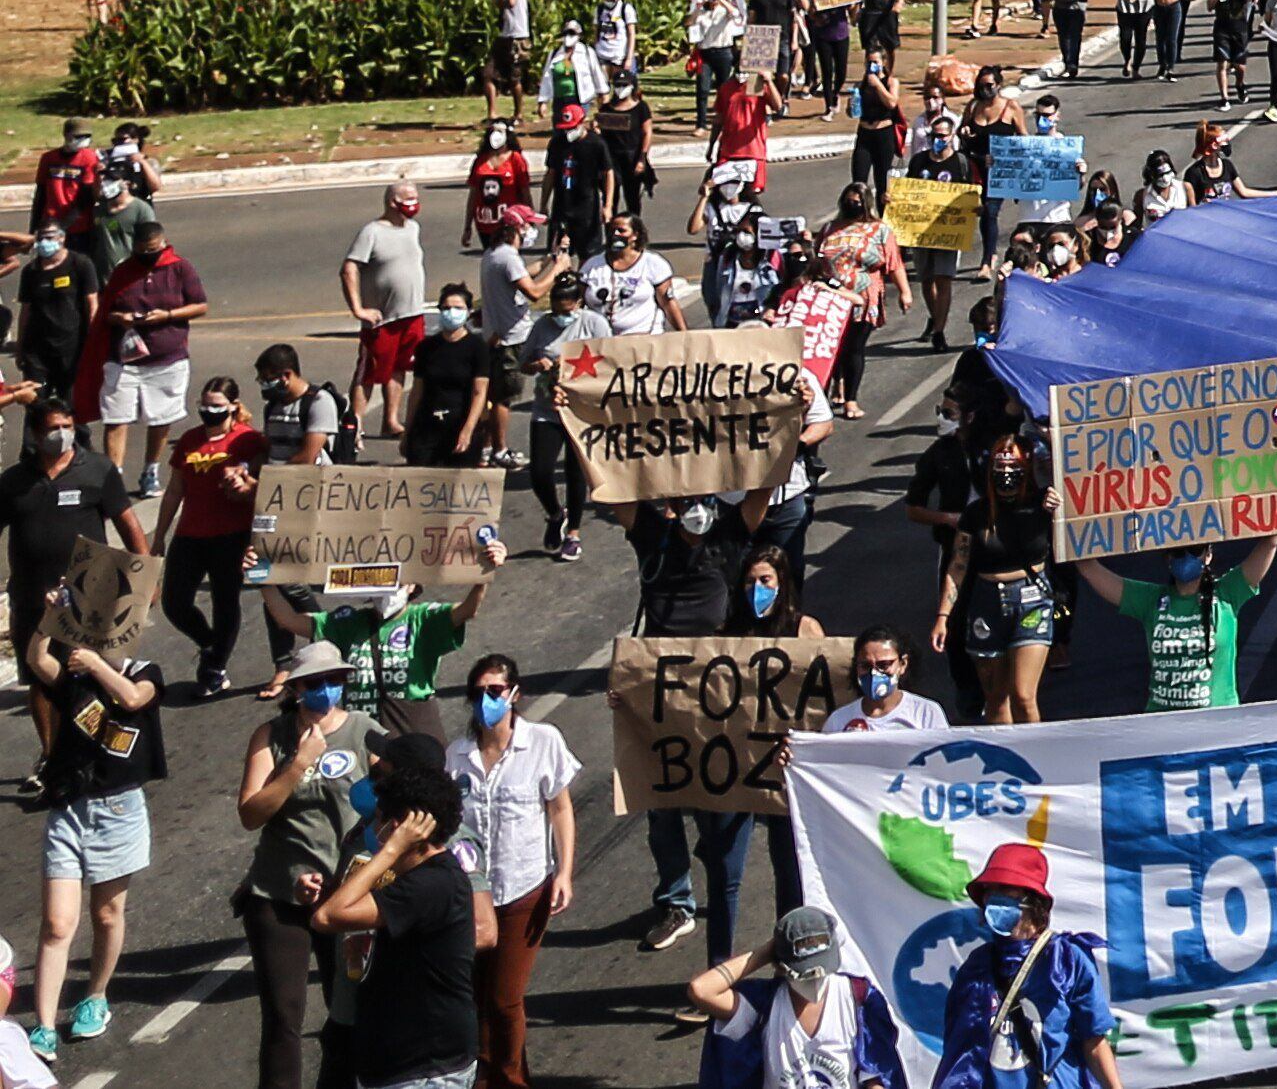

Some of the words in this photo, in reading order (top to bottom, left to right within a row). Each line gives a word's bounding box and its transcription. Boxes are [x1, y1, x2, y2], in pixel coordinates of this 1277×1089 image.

[815, 293, 852, 358] PEOPLE
[601, 362, 799, 410] ARQUICELSO
[1064, 385, 1100, 423] SE
[1105, 382, 1127, 417] O
[580, 412, 770, 462] PRESENTE
[1087, 422, 1164, 470] PIOR
[1169, 414, 1235, 462] QUE
[265, 482, 285, 512] A
[295, 472, 412, 511] CIÊNCIA
[420, 479, 494, 510] SALVA
[1179, 464, 1203, 502] O
[420, 515, 478, 567] JÁ
[1067, 517, 1113, 559] VAI
[1199, 504, 1226, 543] A
[1151, 637, 1184, 655] em
[653, 647, 837, 723] FORA
[1171, 667, 1212, 686] puro
[651, 733, 785, 796] BOZ
[920, 778, 1027, 822] UBES
[1161, 763, 1264, 837] EM
